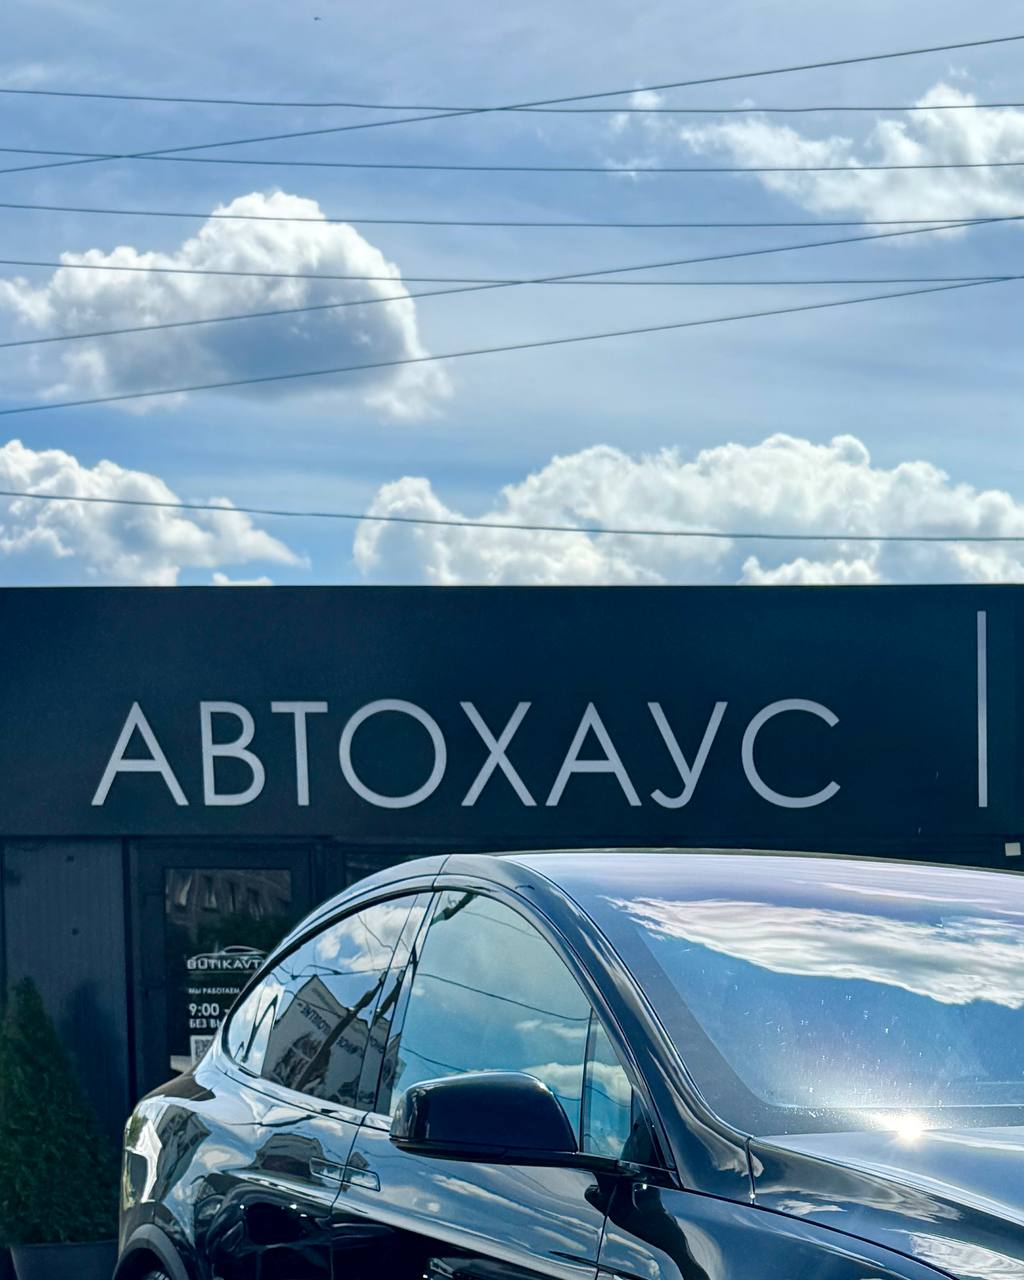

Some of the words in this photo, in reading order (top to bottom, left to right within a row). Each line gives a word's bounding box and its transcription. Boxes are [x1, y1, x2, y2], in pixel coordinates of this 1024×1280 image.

[92, 699, 841, 809] АВТОХАУС
[187, 959, 265, 970] BUTIKAVT
[189, 1003, 219, 1016] 9:00
[190, 1019, 208, 1029] БЕЗ
